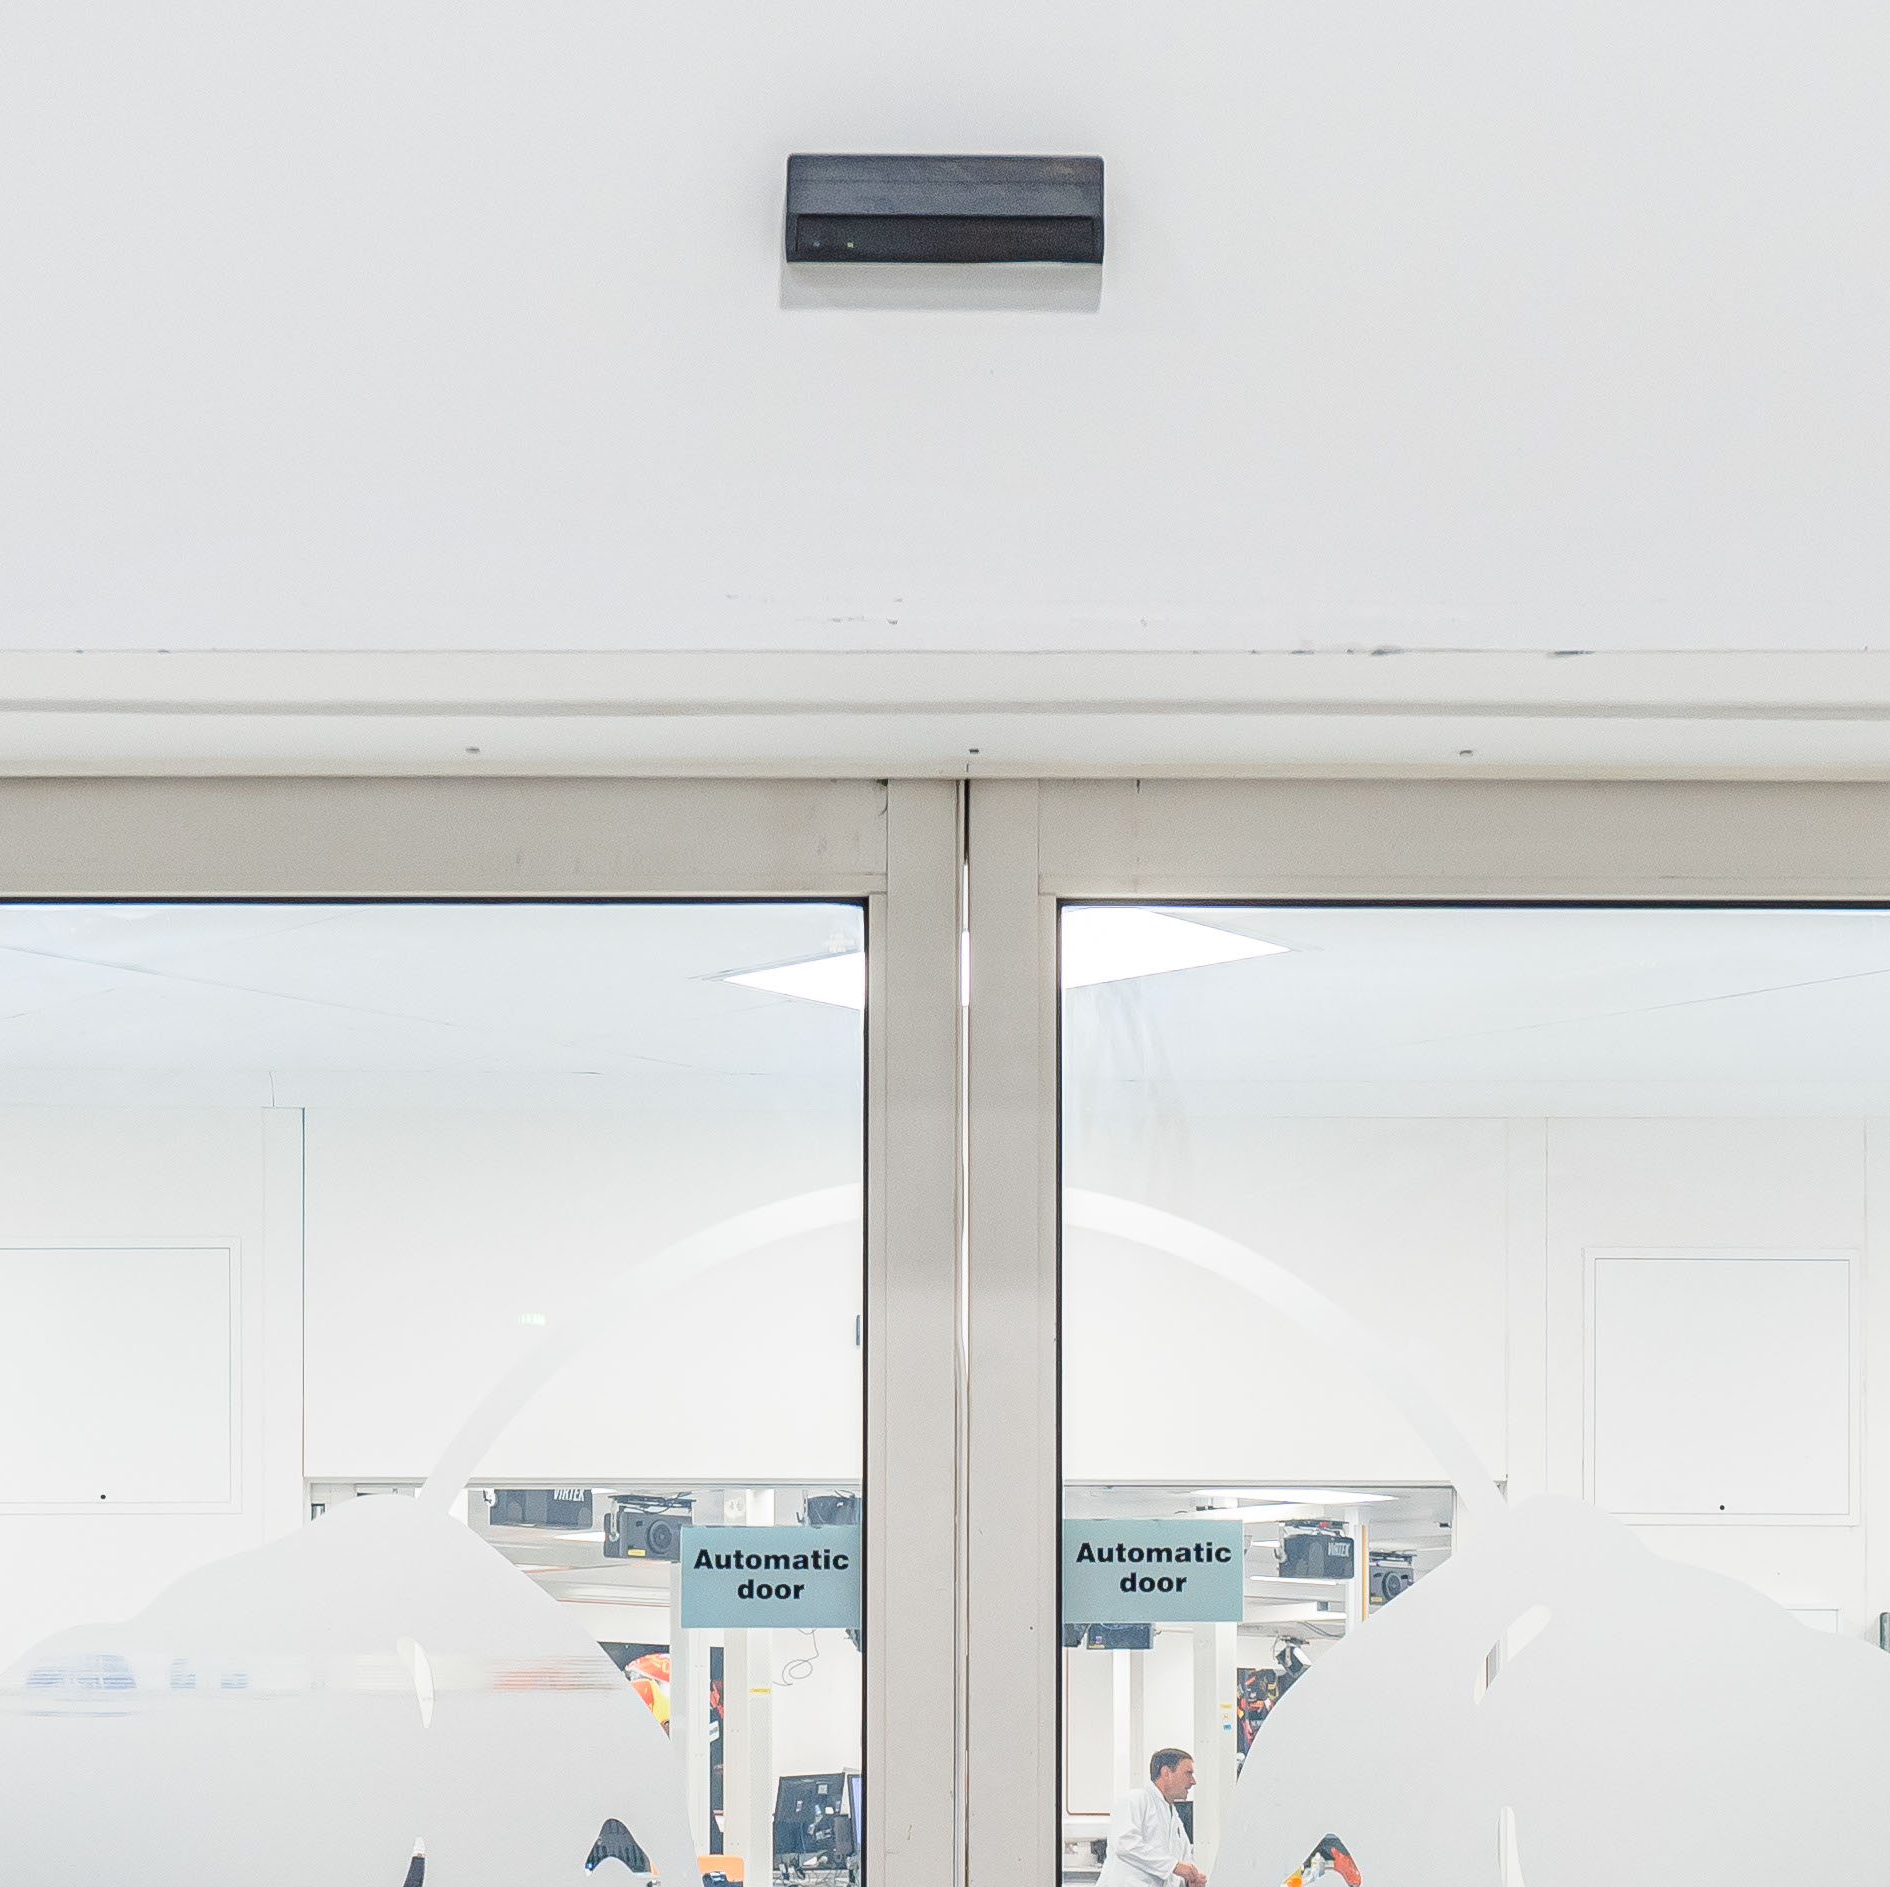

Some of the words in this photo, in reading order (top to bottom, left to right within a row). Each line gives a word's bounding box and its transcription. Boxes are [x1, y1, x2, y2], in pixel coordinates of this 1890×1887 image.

[693, 1548, 850, 1571] Automatic
[1075, 1541, 1232, 1563] Automatic
[737, 1579, 805, 1600] door
[1119, 1572, 1187, 1593] door
